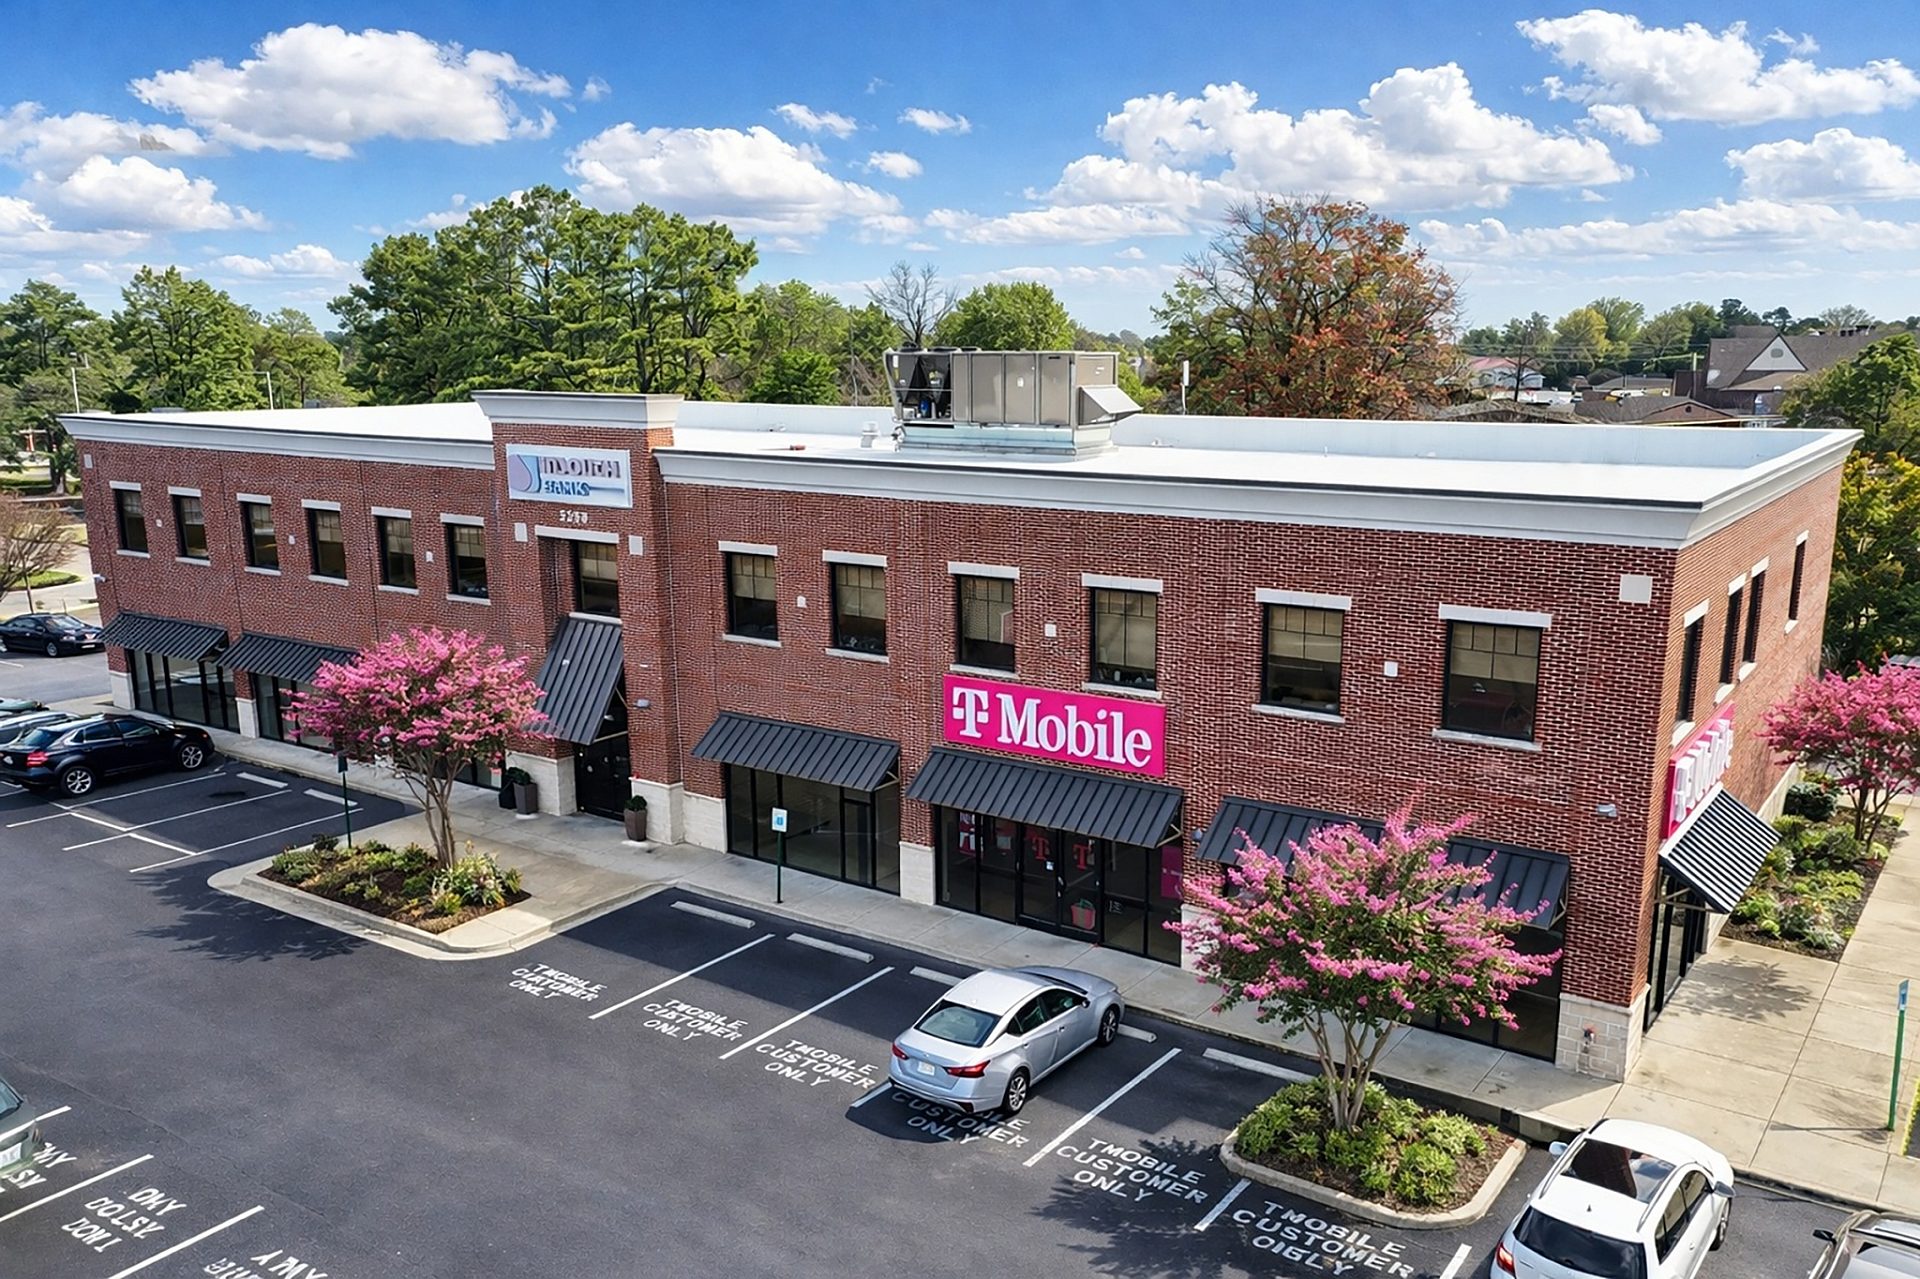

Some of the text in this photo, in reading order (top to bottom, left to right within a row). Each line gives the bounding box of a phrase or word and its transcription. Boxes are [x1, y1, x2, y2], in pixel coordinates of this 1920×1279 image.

[995, 693, 1152, 768] Mobile
[643, 1019, 701, 1040] ONLY
[764, 1062, 830, 1086] ONLY
[785, 1039, 878, 1075] TMOBILE
[907, 1116, 980, 1144] ONLY
[1056, 1145, 1208, 1203] CUSTOMER
[1088, 1137, 1206, 1184] TMOBILE
[1073, 1170, 1154, 1201] ONLY
[1232, 1204, 1414, 1279] CUSTOMER
[1264, 1200, 1406, 1258] TMOBILE
